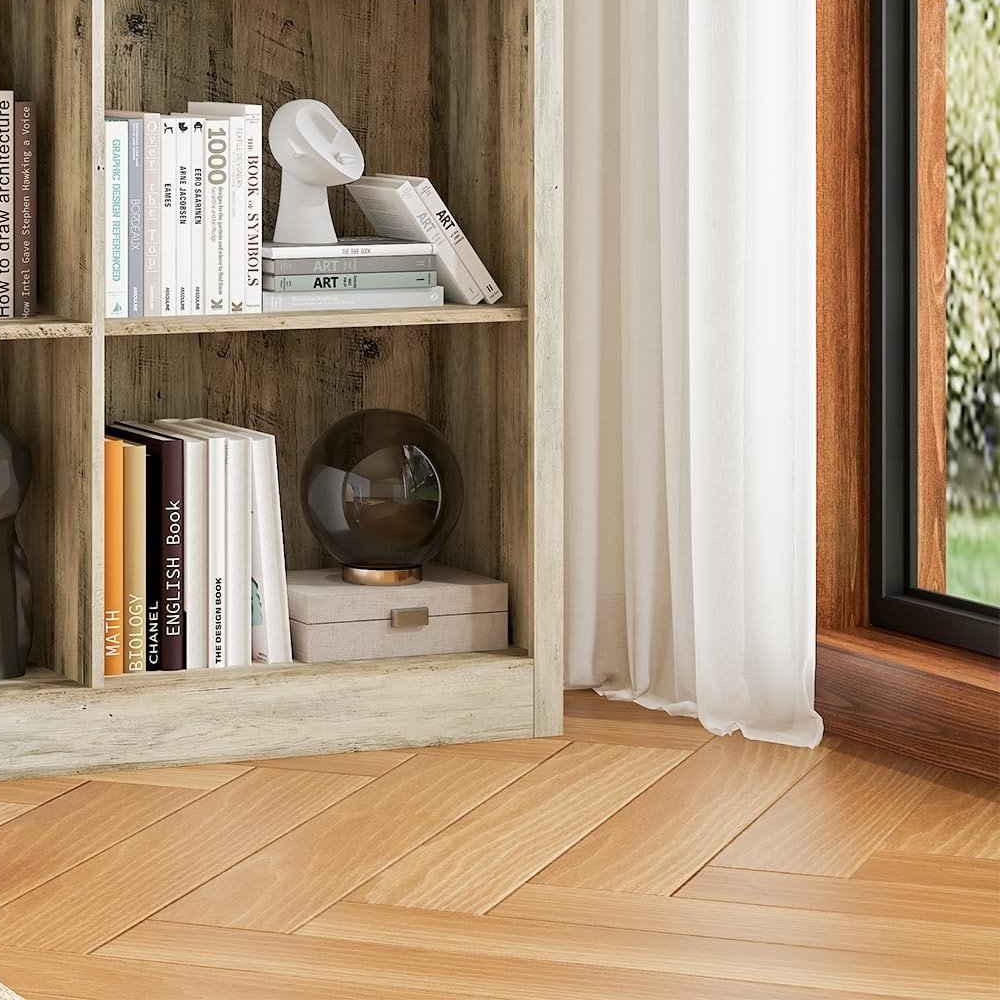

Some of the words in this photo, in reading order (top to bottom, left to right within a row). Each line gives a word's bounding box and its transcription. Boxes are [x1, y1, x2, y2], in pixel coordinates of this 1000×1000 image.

[22, 106, 30, 135] Voice
[22, 152, 32, 191] Hawking
[112, 139, 120, 180] GRAPHIC
[207, 128, 226, 185] 1000
[248, 156, 259, 196] BOOK
[22, 196, 32, 235] Stephen
[112, 184, 120, 218] DESIGN
[436, 210, 455, 230] ART
[131, 200, 140, 250] BORDEAUX
[417, 212, 436, 232] ART
[22, 241, 30, 263] Gave
[112, 219, 120, 282] REFERENCED
[248, 213, 259, 286] SYMBOLS
[313, 260, 339, 272] ART
[22, 269, 30, 296] Intel
[313, 277, 338, 288] ART
[166, 500, 180, 545] Book
[167, 557, 180, 636] ENGLISH
[106, 609, 120, 656] MATH
[129, 594, 143, 671] BIOLOGY
[149, 601, 158, 664] CHANEL
